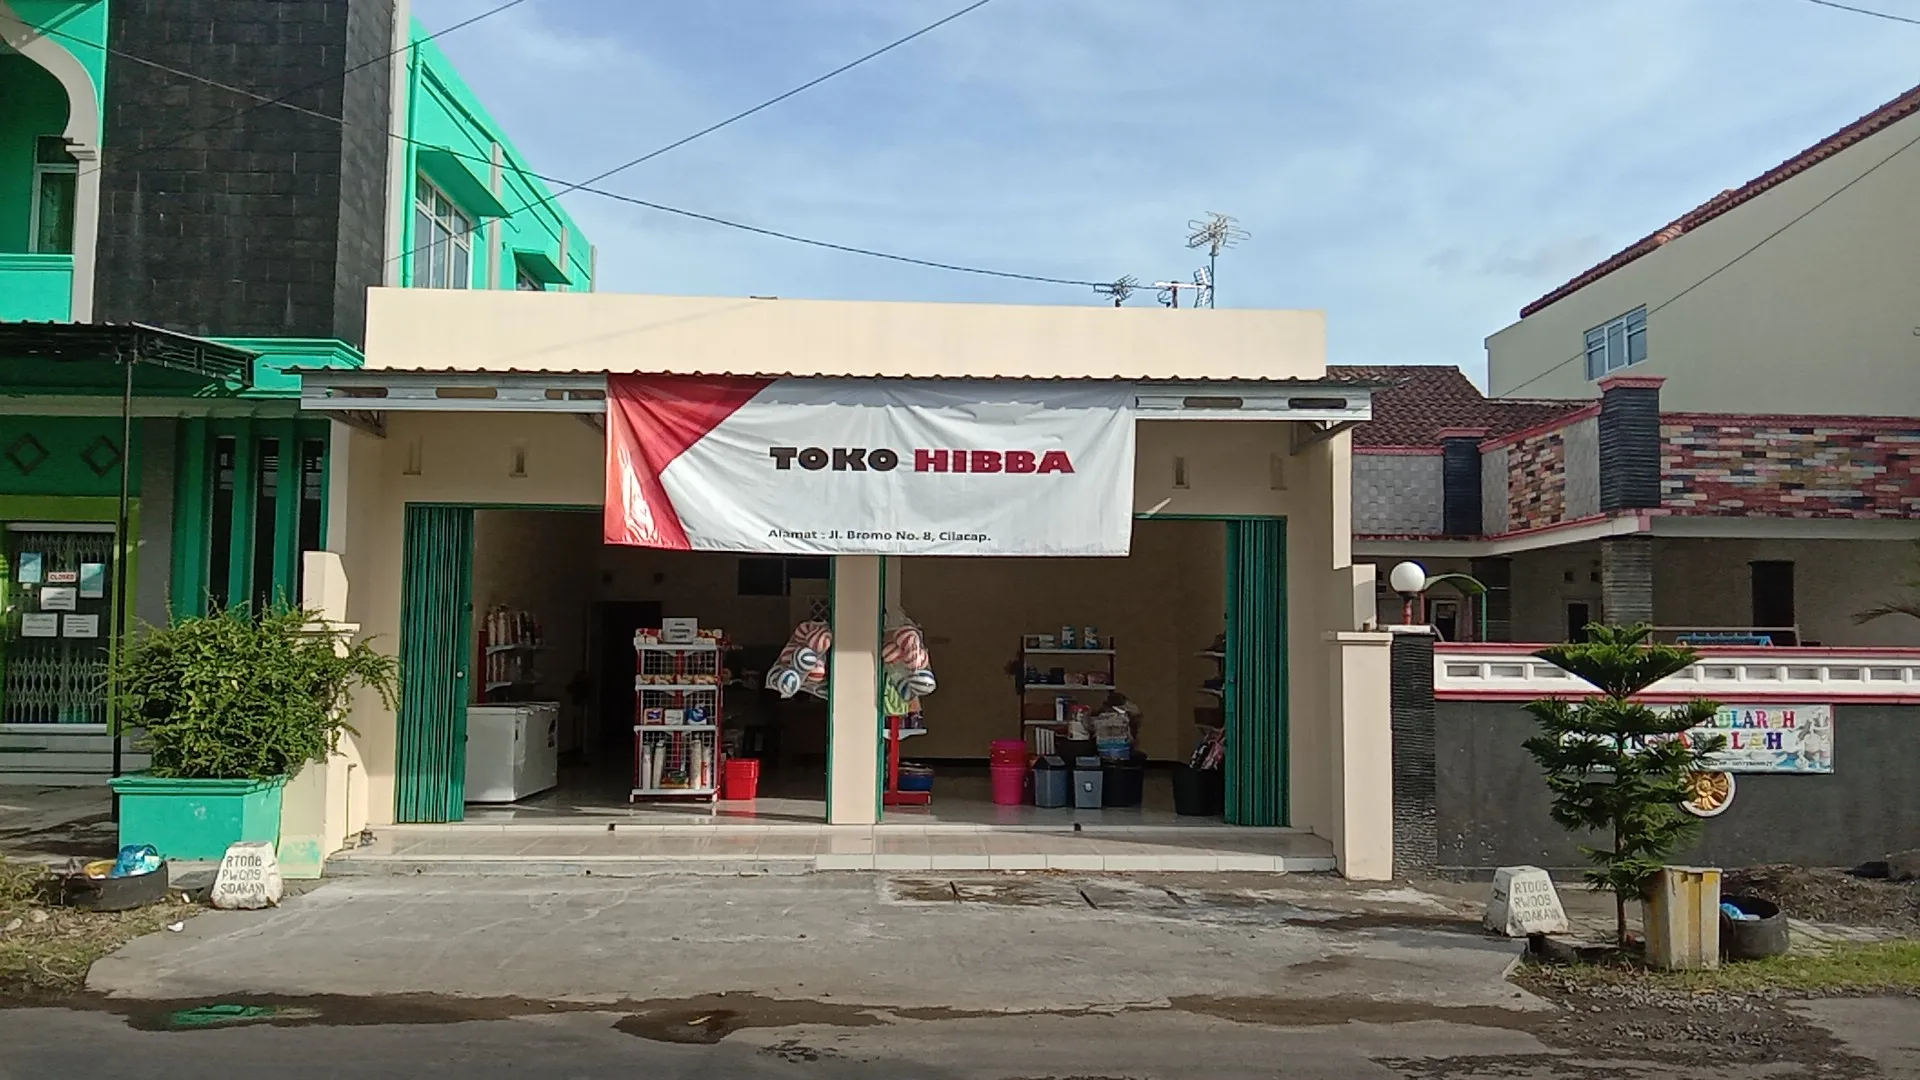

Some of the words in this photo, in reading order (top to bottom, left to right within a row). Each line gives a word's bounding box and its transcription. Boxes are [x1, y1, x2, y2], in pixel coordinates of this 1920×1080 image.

[769, 446, 899, 472] TOKO
[913, 448, 1076, 474] HIBBA
[767, 529, 818, 539] Alamat
[828, 530, 844, 540] Jl.
[847, 530, 893, 540] Bromo
[896, 530, 920, 541] No.
[938, 531, 992, 543] Cilacap.
